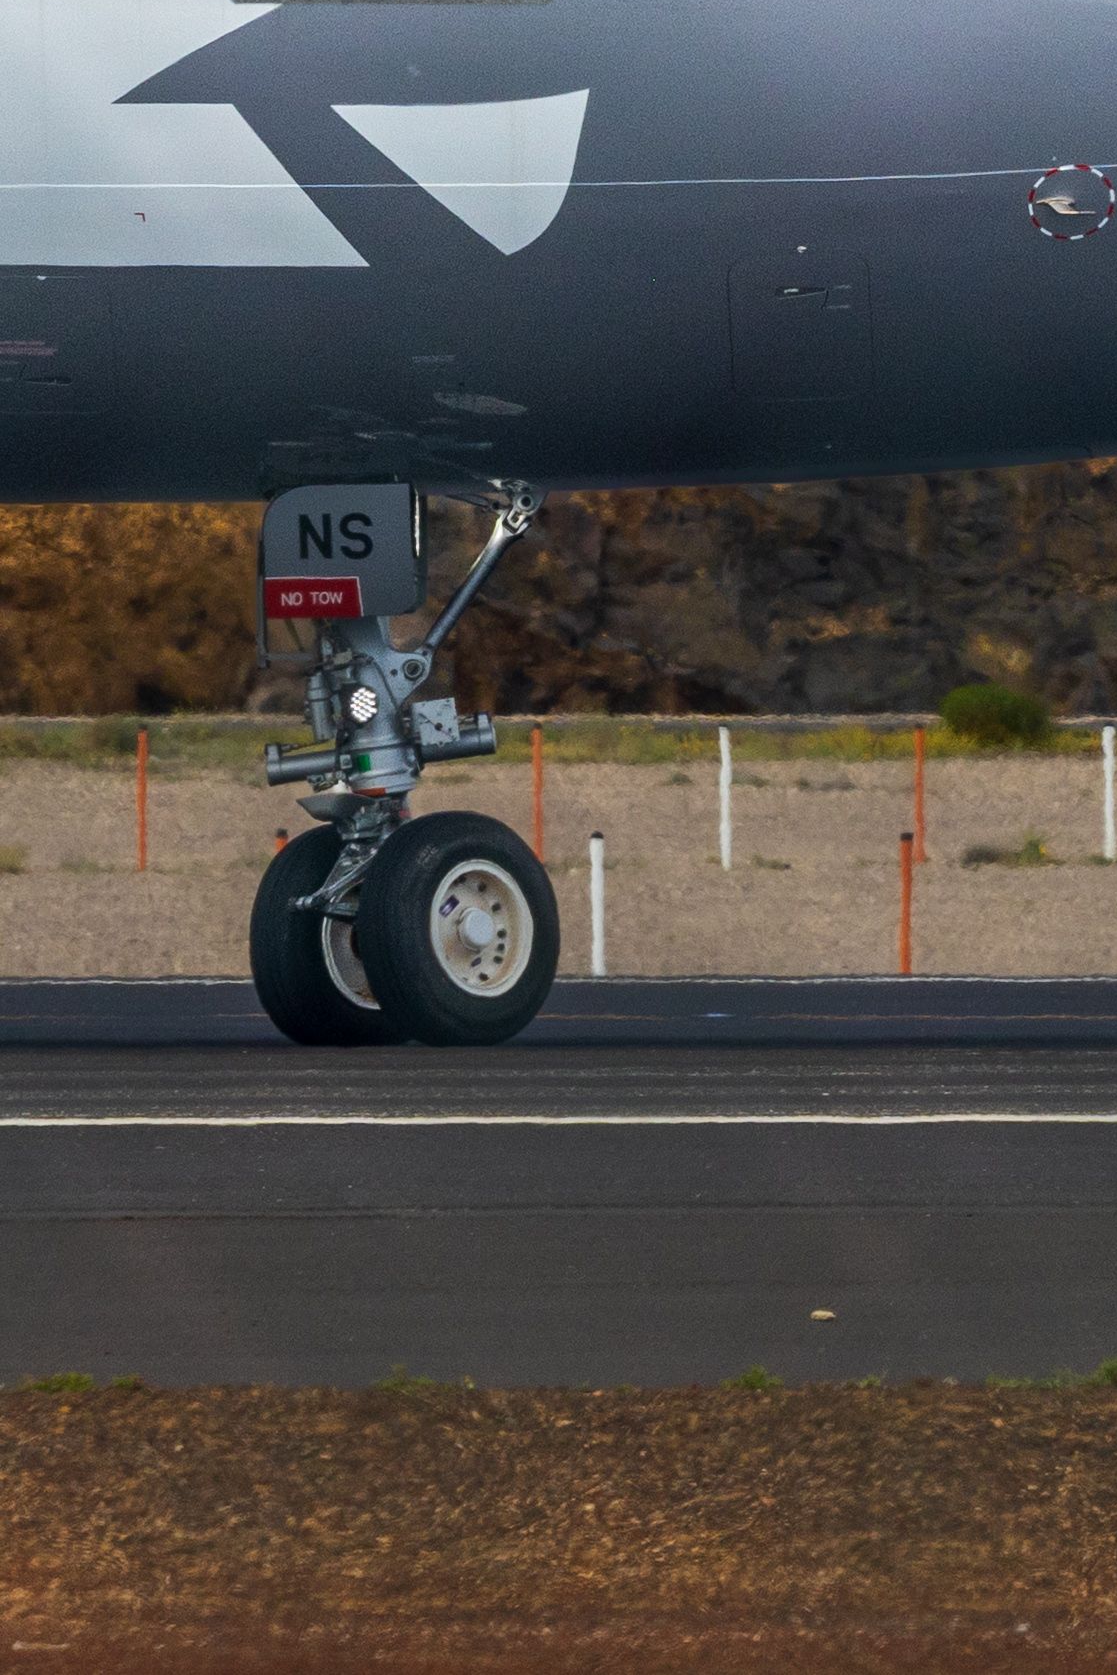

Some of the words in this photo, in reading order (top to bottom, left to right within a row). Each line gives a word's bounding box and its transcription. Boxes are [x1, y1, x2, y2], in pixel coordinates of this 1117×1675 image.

[299, 512, 373, 560] NS
[281, 592, 303, 606] NO
[309, 591, 343, 605] TOW
